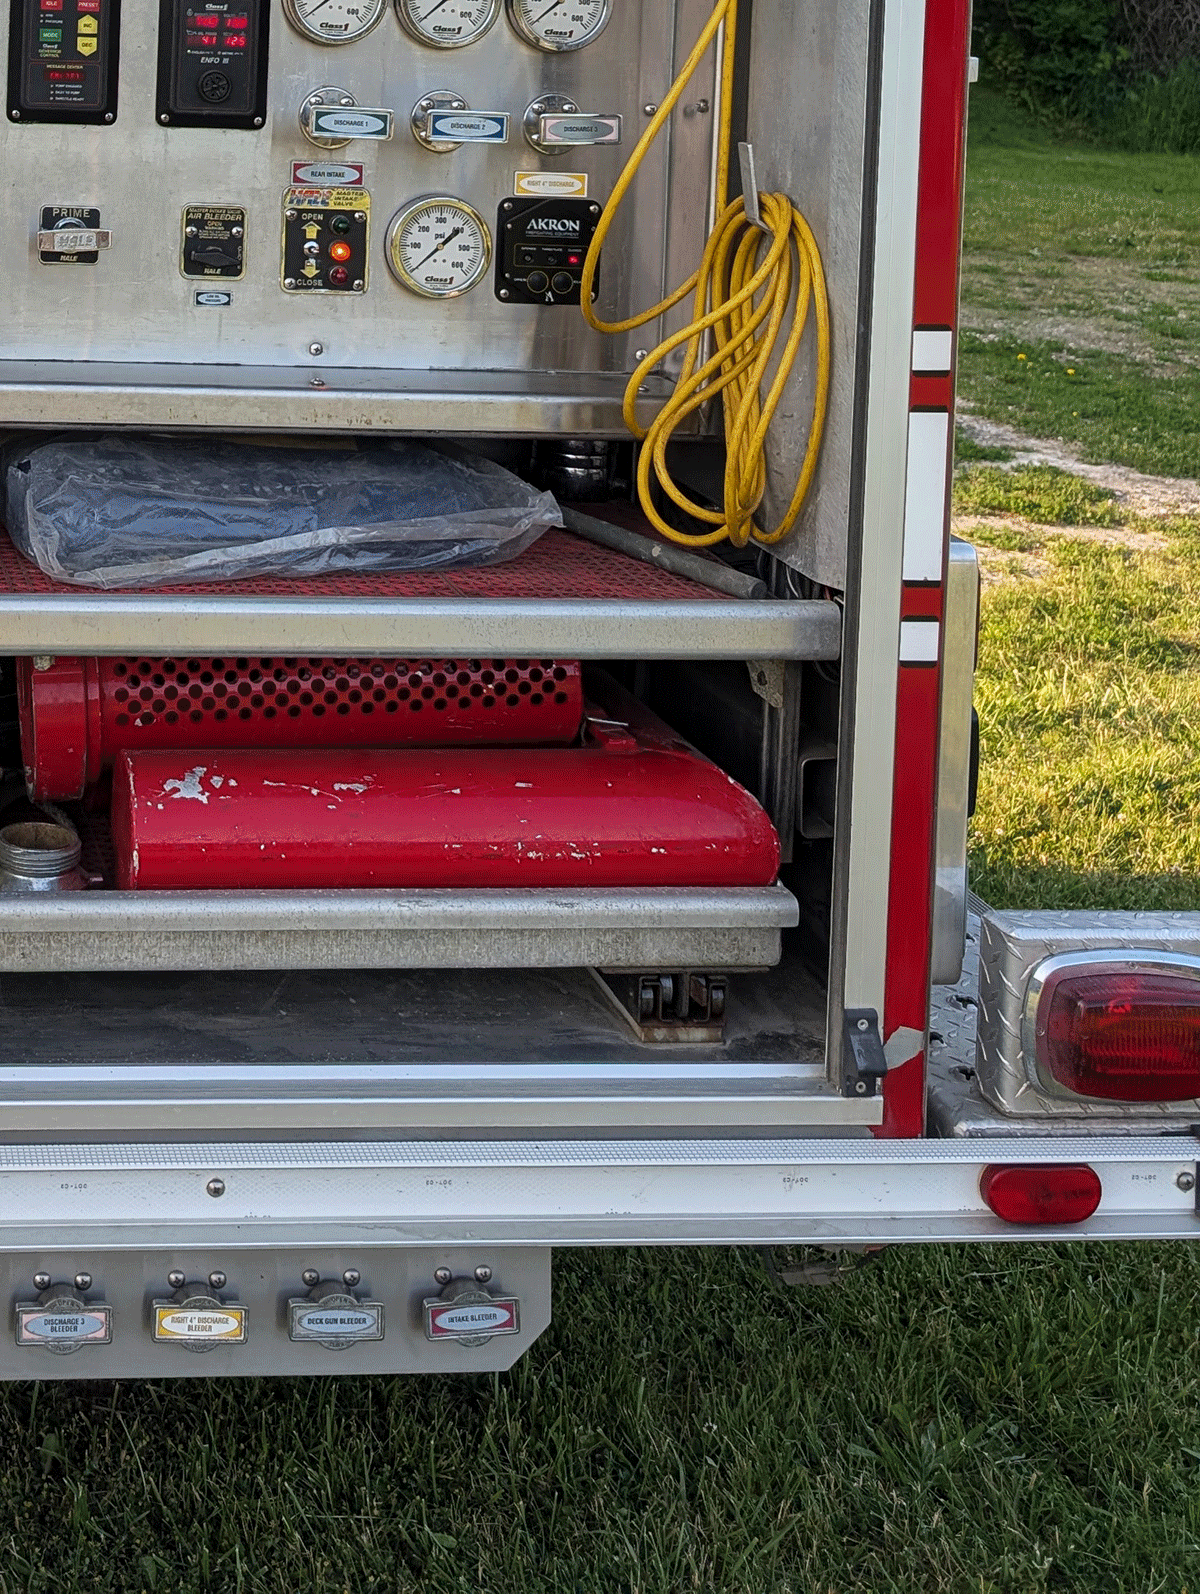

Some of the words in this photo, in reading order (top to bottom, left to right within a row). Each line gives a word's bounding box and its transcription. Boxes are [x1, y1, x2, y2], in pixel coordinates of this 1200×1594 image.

[334, 119, 364, 127] DISCHARGE
[450, 122, 480, 130] DISCHARGE
[563, 125, 592, 133] DISCHARGE
[52, 208, 91, 218] PRIME
[187, 212, 203, 220] AIR
[203, 213, 242, 221] BLEEDER
[301, 213, 324, 221] OPEN
[526, 218, 580, 232] AKRON
[203, 267, 222, 275] HALE
[296, 279, 323, 287] CLOSE
[44, 1317, 79, 1326] DISCHARGE
[80, 1317, 85, 1325] 3
[170, 1316, 188, 1325] RIGHT
[197, 1317, 230, 1326] DISCHARGE
[307, 1317, 324, 1325] DECK
[325, 1317, 339, 1325] GUN
[339, 1316, 368, 1325] BLEEDER
[447, 1314, 469, 1324] INTAKE
[470, 1313, 498, 1322] BLEEDER
[50, 1324, 79, 1333] BLEEDER
[187, 1324, 213, 1333] BLEEDER
